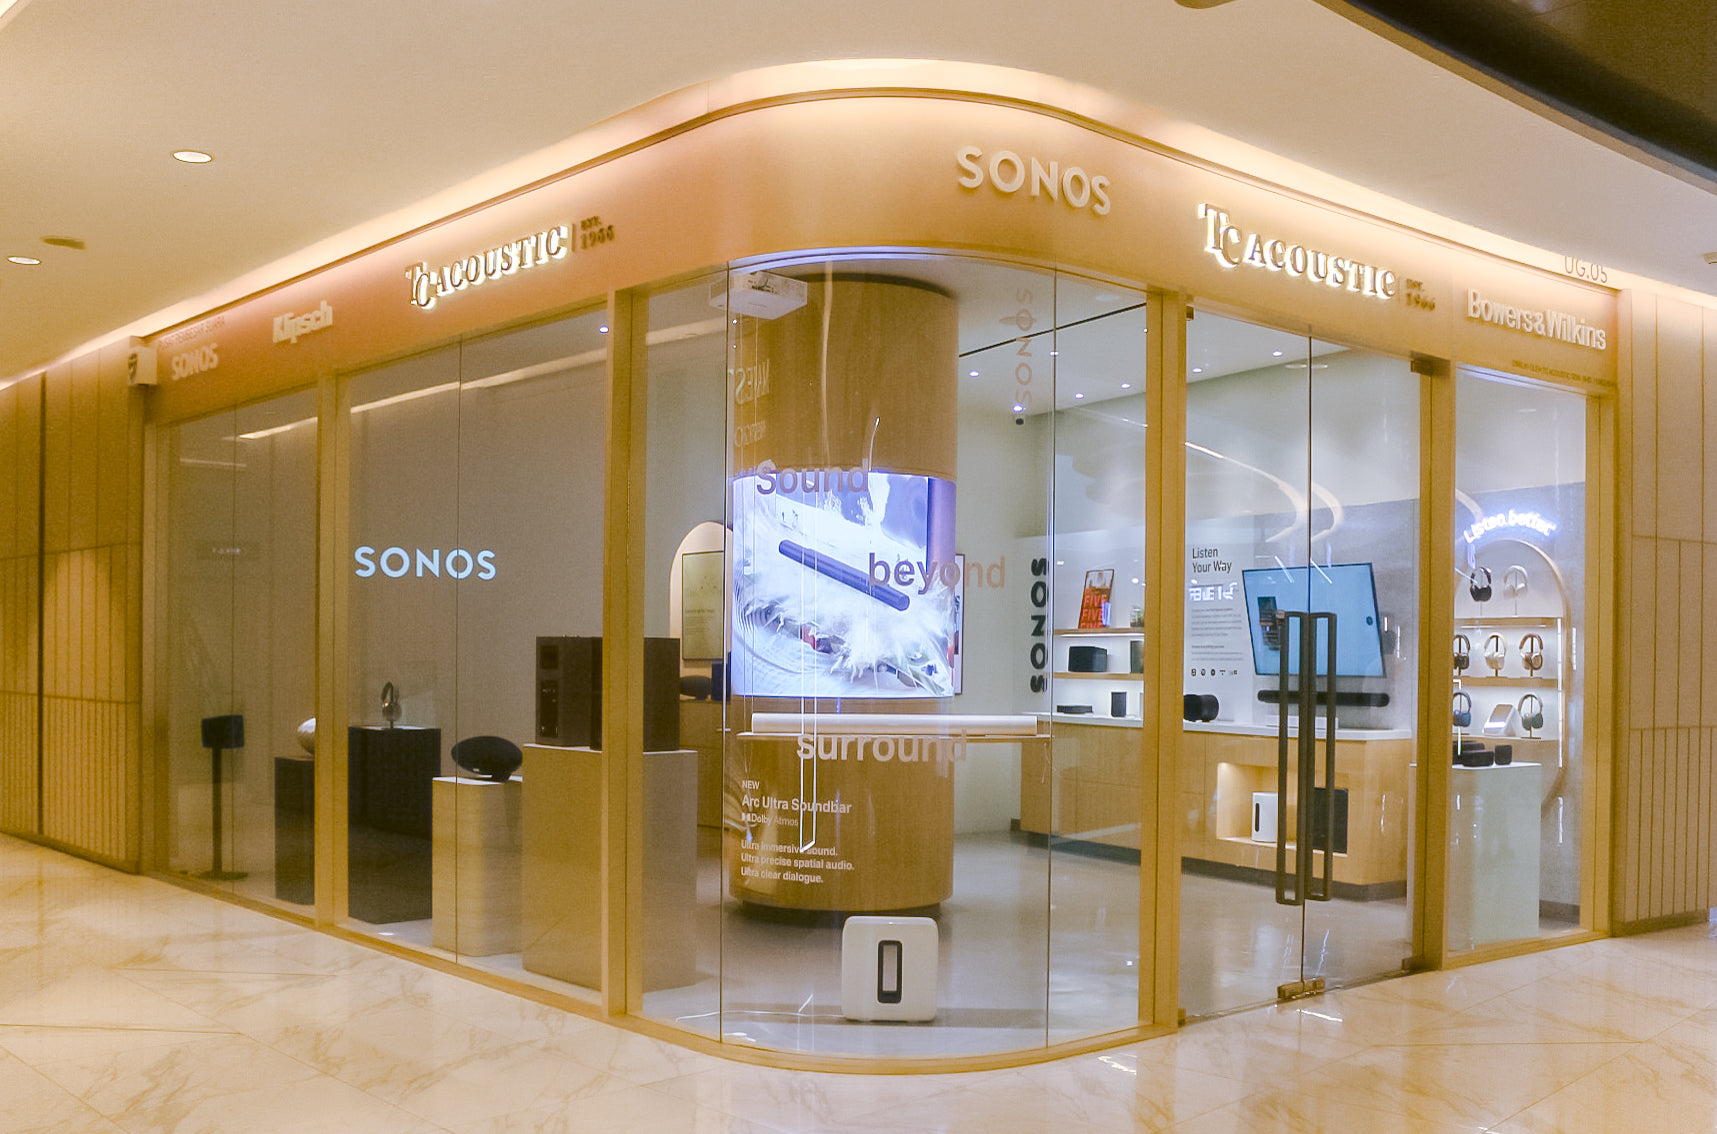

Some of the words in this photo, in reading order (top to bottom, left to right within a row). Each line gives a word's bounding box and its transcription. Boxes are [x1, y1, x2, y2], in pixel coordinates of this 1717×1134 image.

[957, 145, 1111, 216] SONOS
[436, 225, 569, 297] ACOUSTIC
[1243, 232, 1397, 300] ACOUSTIC
[273, 300, 333, 344] Klipsch
[172, 343, 218, 381] SONOS
[756, 459, 869, 495] Sound
[354, 545, 497, 581] SONOS
[1192, 547, 1219, 559] Listen
[1192, 561, 1211, 573] Your
[1213, 560, 1232, 574] Way
[869, 552, 1006, 595] beyond
[1030, 557, 1048, 693] SONOS
[797, 728, 967, 762] surround
[742, 780, 760, 789] NEW
[742, 795, 760, 807] Arc
[762, 796, 789, 810] Ultra
[791, 798, 852, 813] Soundbar
[751, 813, 773, 826] Dolby
[741, 853, 760, 864] Ultra
[760, 855, 792, 867] precise
[793, 859, 824, 869] spatial
[825, 860, 855, 871] audio.
[741, 867, 760, 877] Ultra
[760, 869, 782, 879] clear
[782, 871, 824, 884] dialogue.
